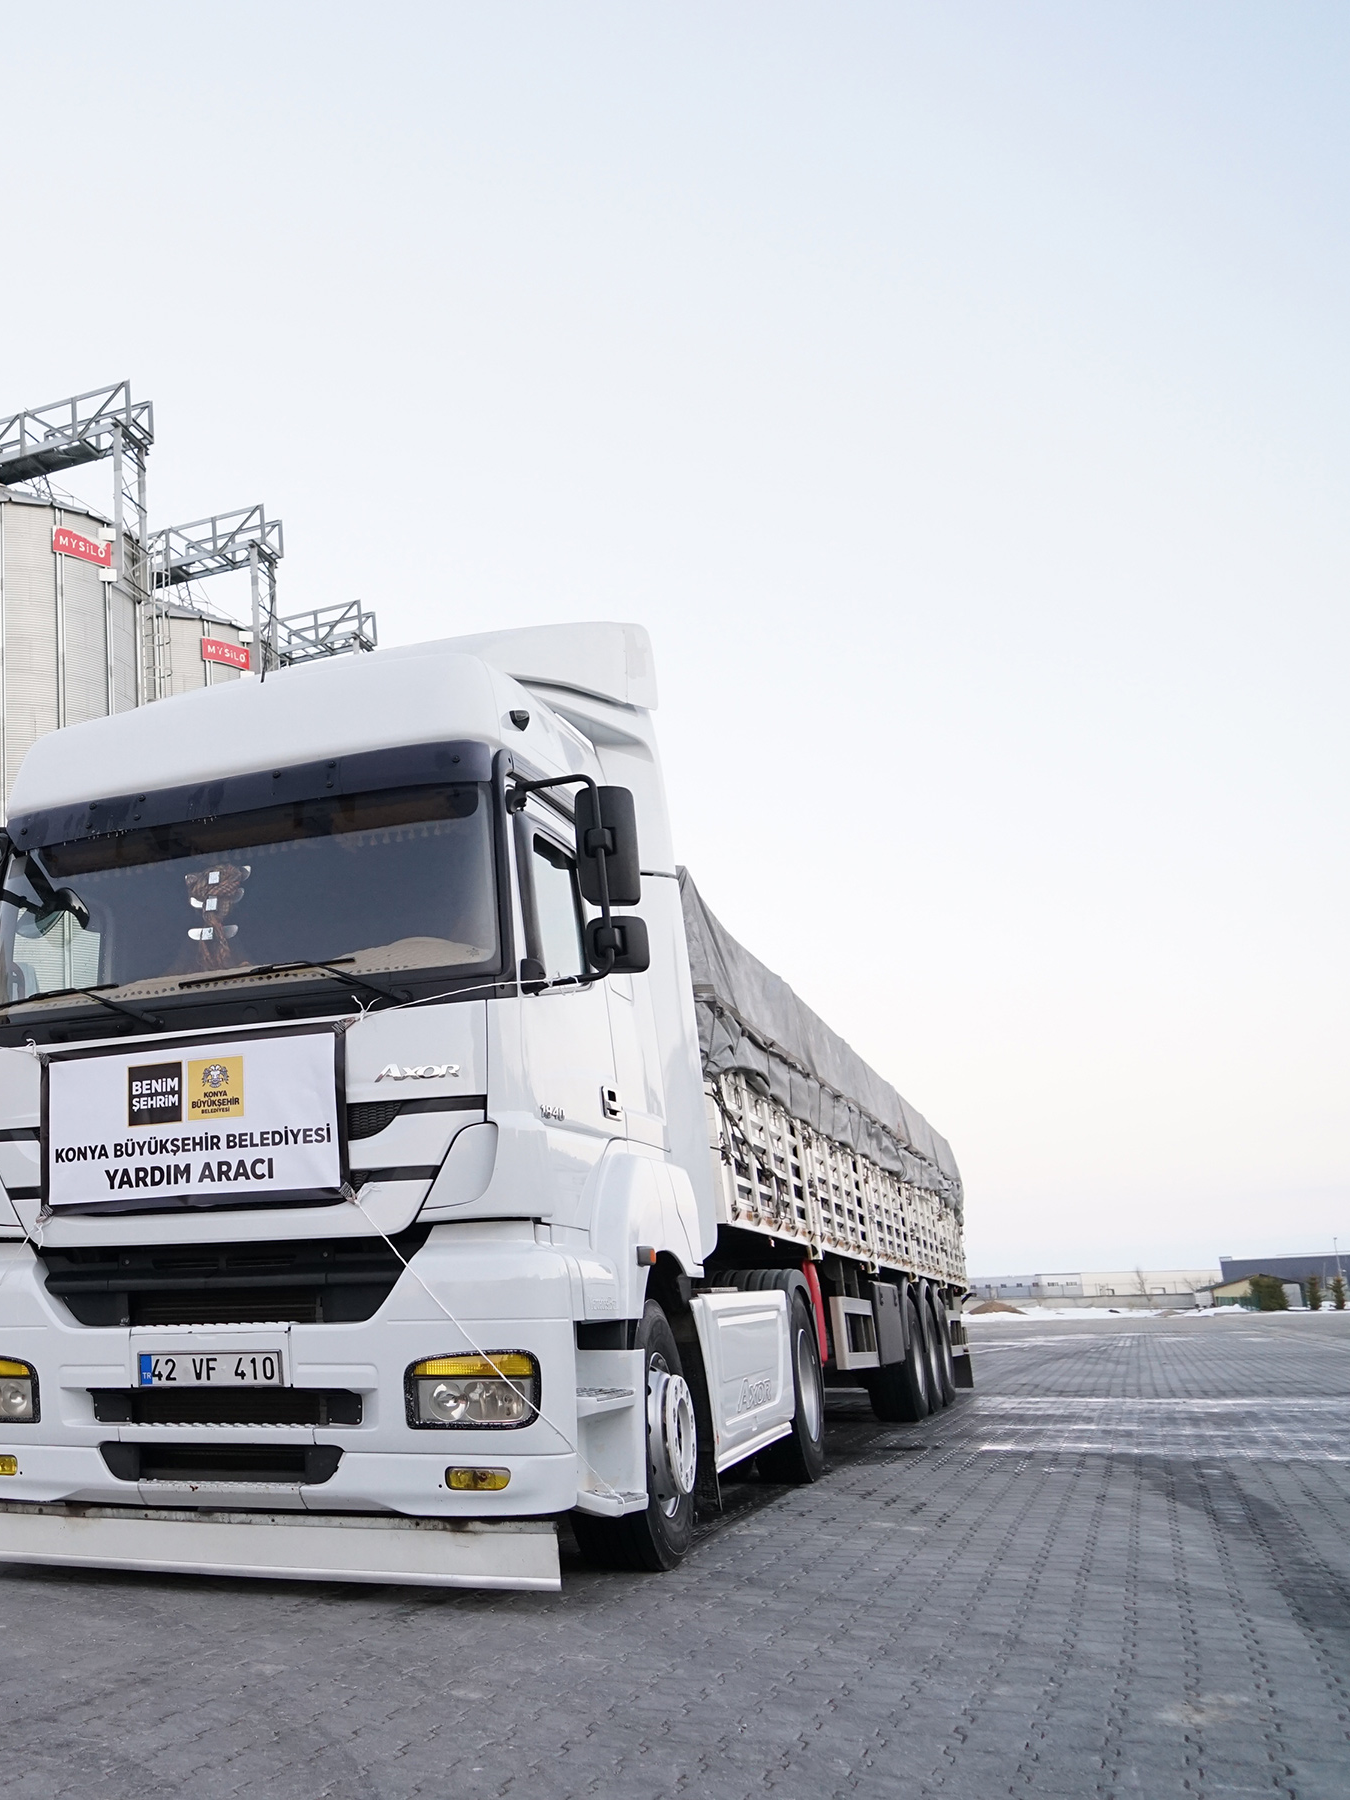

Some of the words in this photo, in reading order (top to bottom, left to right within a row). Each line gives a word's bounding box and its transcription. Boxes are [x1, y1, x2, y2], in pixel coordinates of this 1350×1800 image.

[373, 1063, 460, 1083] AXOR
[191, 1096, 240, 1109] BÜYÜKŞEHİR
[203, 1090, 228, 1098] KONYA
[54, 1144, 109, 1164] KONYA
[113, 1131, 221, 1158] BÜYÜKŞEHİR
[226, 1123, 332, 1150] BELEDİYESİ
[105, 1163, 191, 1190] YARDIM
[198, 1157, 274, 1184] ARACI
[142, 1372, 151, 1380] TR
[152, 1358, 177, 1381] 42
[192, 1358, 218, 1381] VF
[234, 1356, 275, 1381] 410
